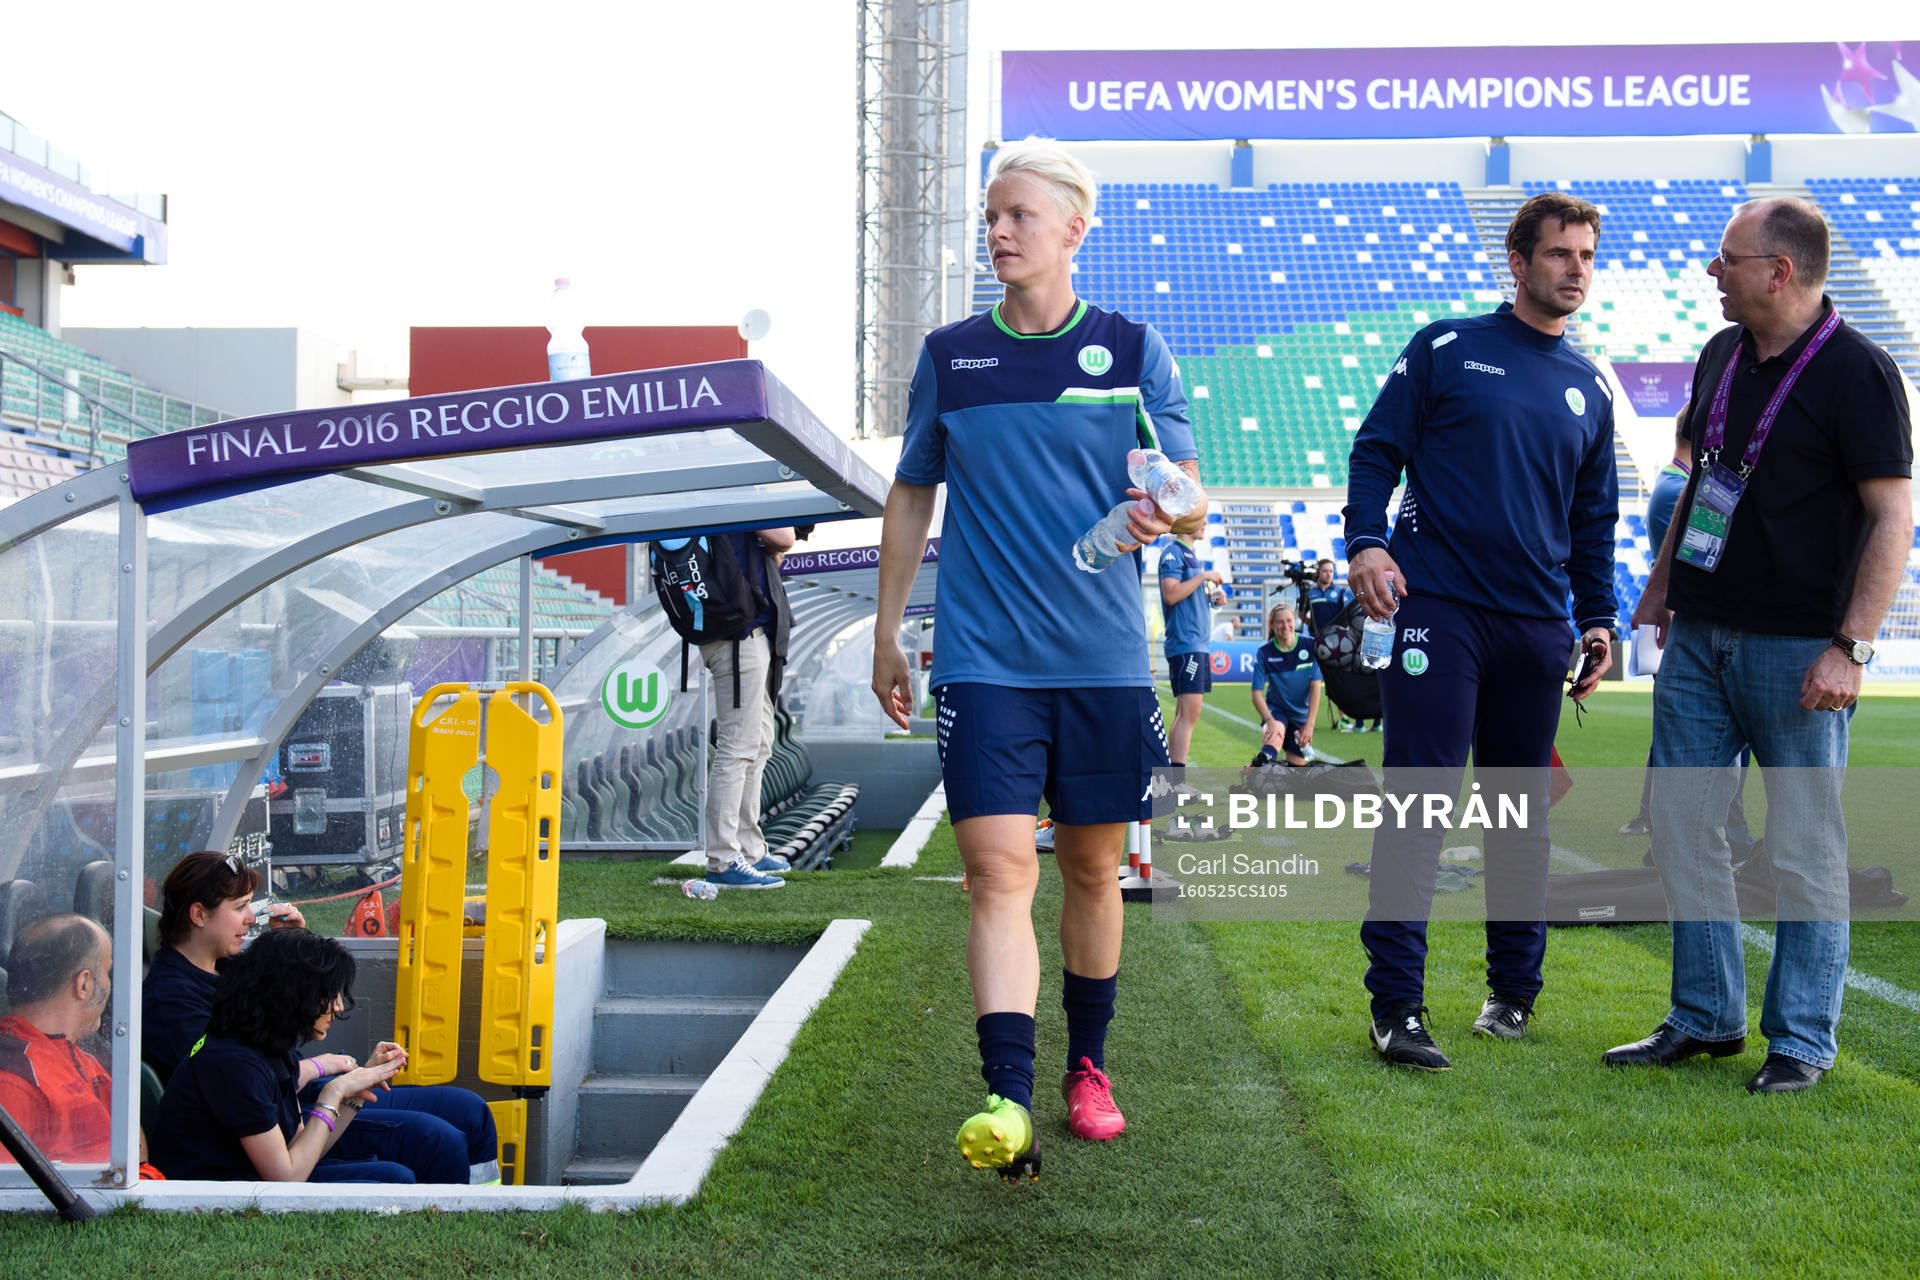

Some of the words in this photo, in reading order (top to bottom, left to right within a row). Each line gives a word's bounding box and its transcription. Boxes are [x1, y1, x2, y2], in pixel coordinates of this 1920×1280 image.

[1068, 80, 1172, 112] UEFA
[1177, 78, 1357, 112] WOMEN'S
[1366, 76, 1593, 110] CHAMPIONS
[1603, 74, 1751, 107] LEAGUE
[951, 357, 999, 370] Kappa
[1464, 360, 1506, 376] Kappa
[187, 422, 306, 466] FINAL
[317, 411, 401, 452] 2016
[409, 390, 570, 440] REGGIO
[582, 375, 723, 421] EMILIA
[783, 555, 814, 570] 2016
[818, 549, 879, 566] REGGIO
[1402, 628, 1429, 642] RK
[616, 671, 658, 713] W
